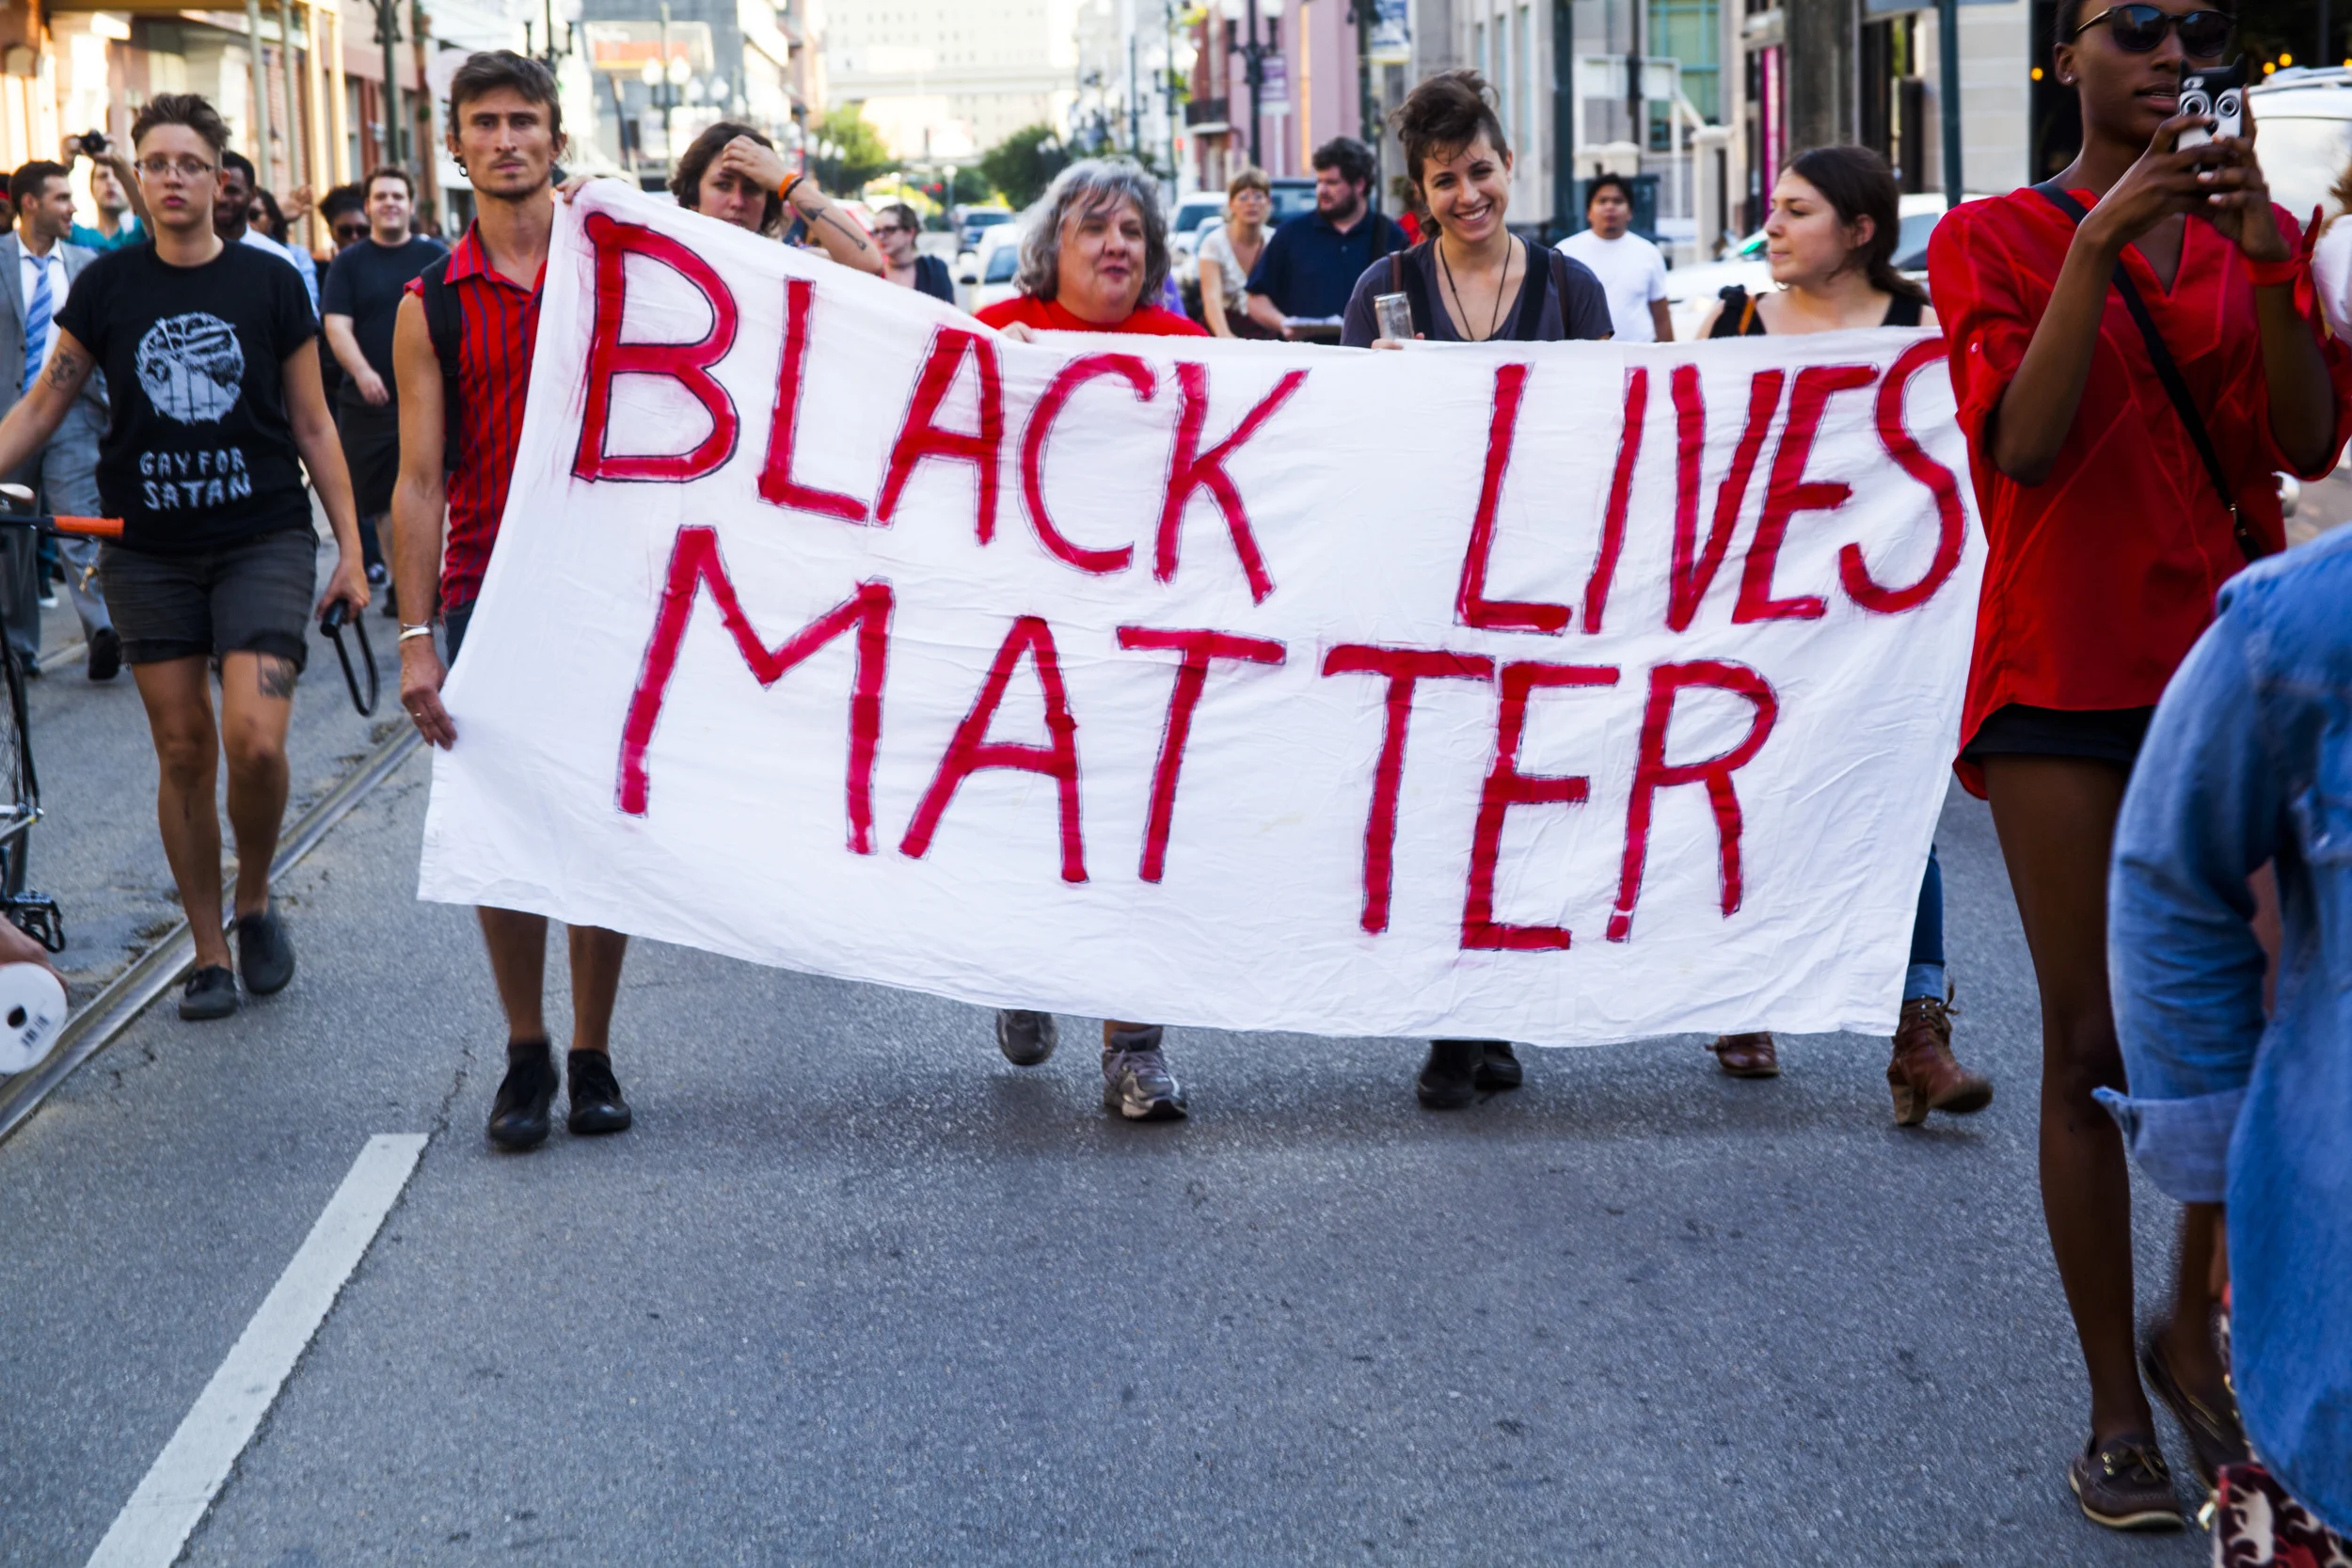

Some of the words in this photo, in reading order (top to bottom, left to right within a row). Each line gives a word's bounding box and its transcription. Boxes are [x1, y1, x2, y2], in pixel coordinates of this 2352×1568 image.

[139, 450, 191, 477] GAY
[198, 447, 246, 475] FOR
[142, 472, 252, 511] SATAN
[571, 212, 1309, 605] BLACK
[1455, 337, 1970, 636] LIVES
[617, 526, 1777, 951] MATTER
